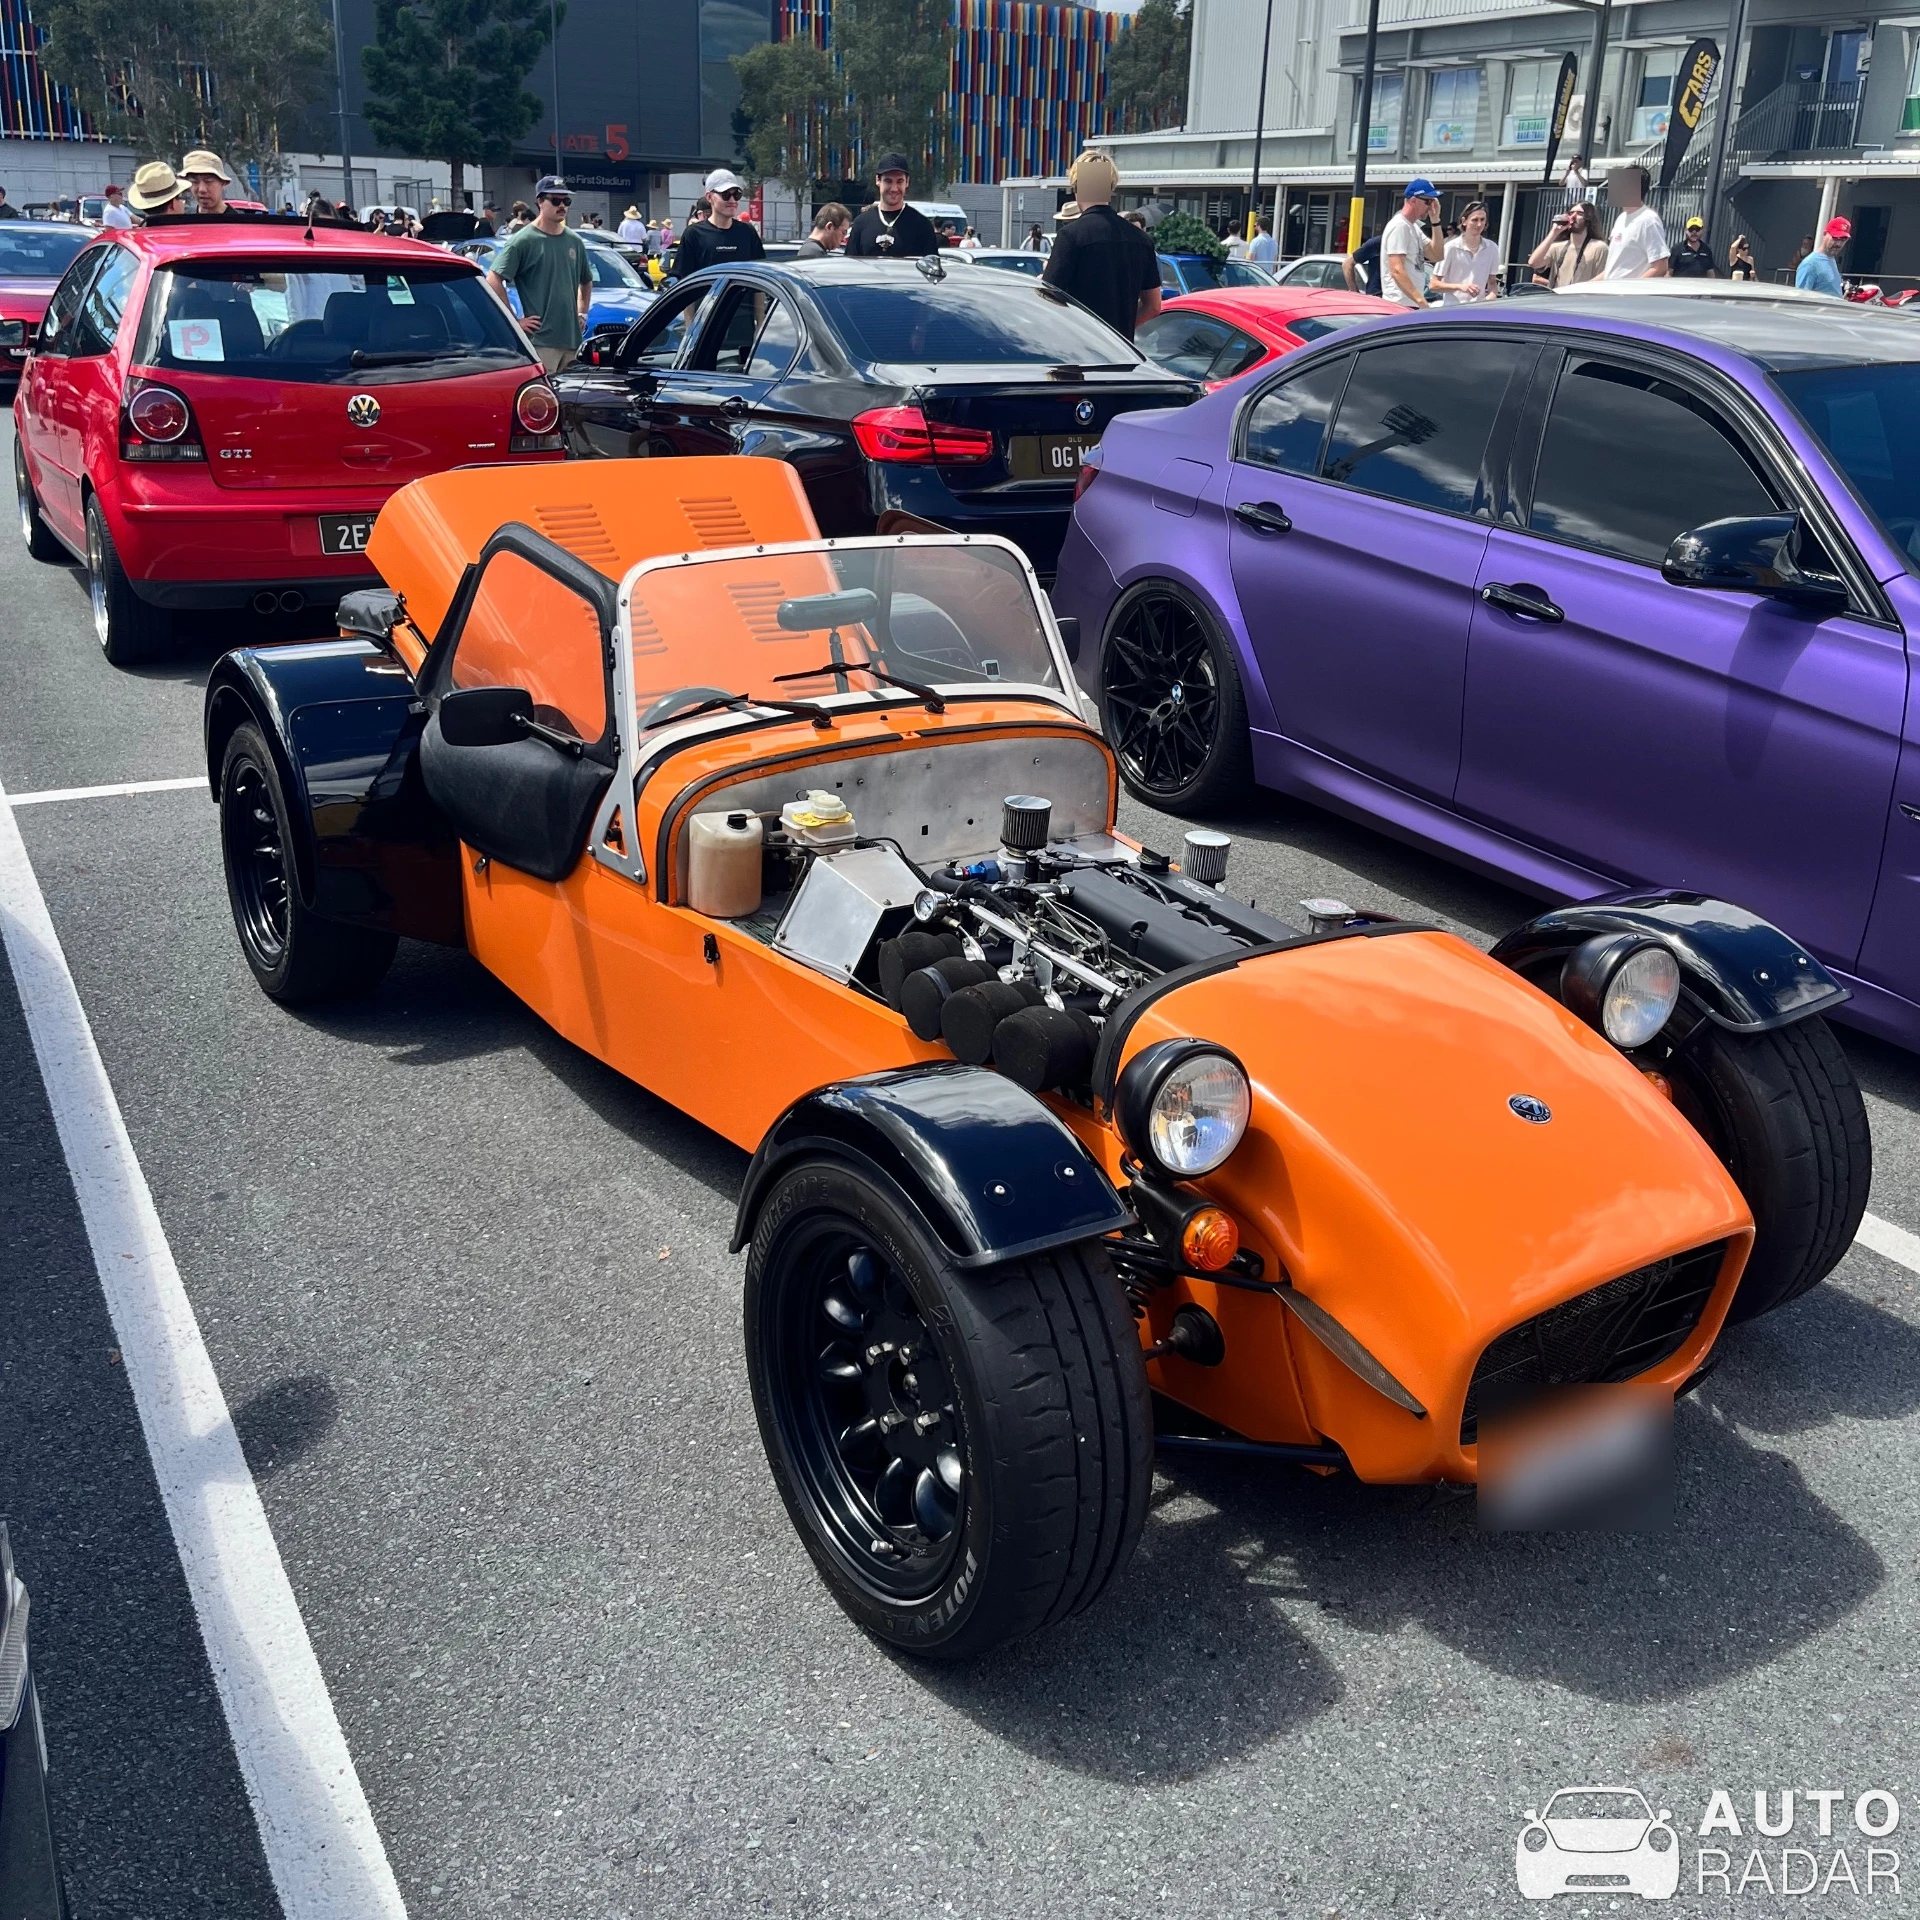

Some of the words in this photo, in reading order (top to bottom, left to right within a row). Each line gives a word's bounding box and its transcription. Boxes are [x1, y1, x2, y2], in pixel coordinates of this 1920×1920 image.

[1679, 51, 1711, 128] CARS
[605, 124, 629, 161] 5
[575, 174, 595, 186] First
[595, 175, 631, 187] Stadium
[181, 325, 210, 356] P
[219, 448, 252, 459] GTI
[1051, 446, 1074, 468] OG
[336, 523, 374, 550] 2E
[750, 1175, 829, 1283] BRIDGESTONE
[880, 1547, 979, 1637] POTENZA
